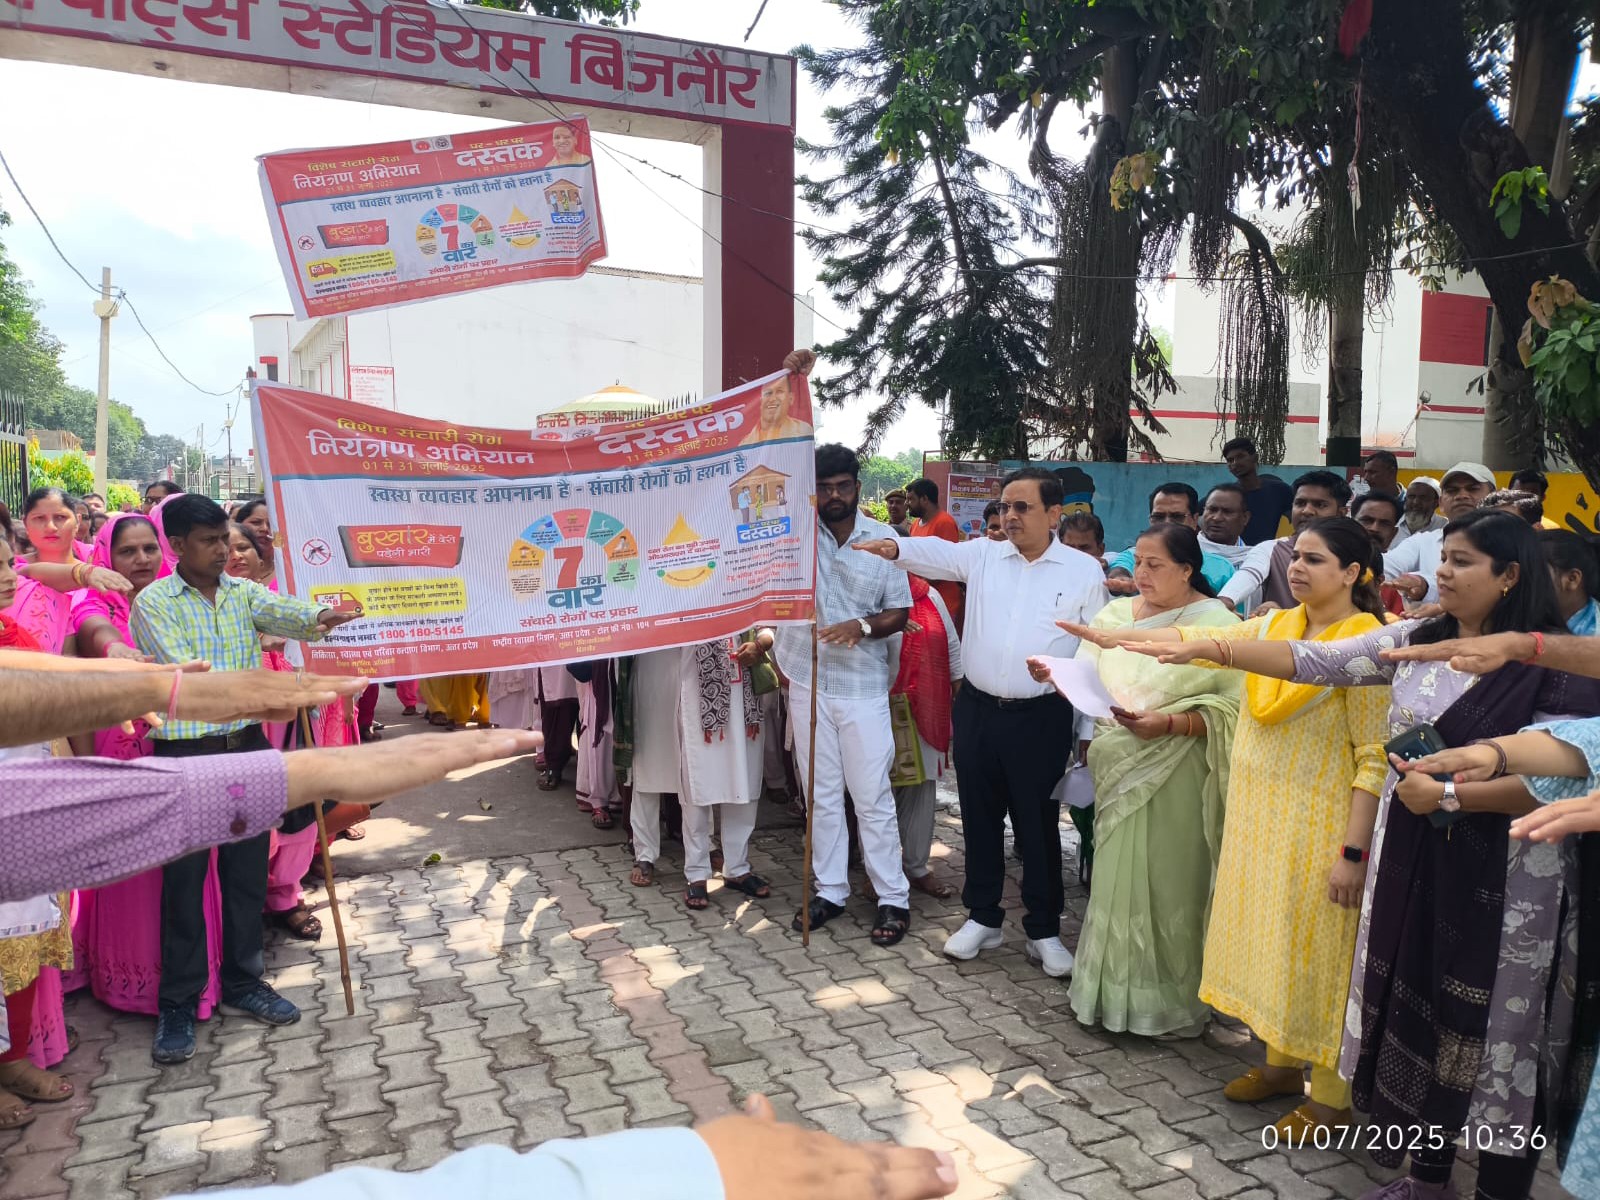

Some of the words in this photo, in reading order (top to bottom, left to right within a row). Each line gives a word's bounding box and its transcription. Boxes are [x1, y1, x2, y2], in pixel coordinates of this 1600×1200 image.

[279, 0, 547, 79] स्टेडियम
[564, 33, 761, 109] बिजनौर
[307, 162, 337, 172] विशेष
[378, 154, 401, 164] रोग
[453, 142, 544, 167] दस्तक
[293, 171, 354, 190] नियंत्रण
[359, 163, 421, 181] अभियान
[394, 190, 434, 204] अपनाना
[454, 183, 480, 197] संचारी
[482, 179, 501, 192] रोगों
[504, 178, 517, 189] को
[519, 175, 543, 188] हराना
[546, 172, 553, 183] है
[440, 224, 459, 250] 7
[441, 246, 478, 262] वार
[691, 402, 715, 416] पर
[336, 417, 388, 435] विशेष
[396, 427, 459, 443] संचारी
[464, 430, 503, 446] रोग
[594, 403, 746, 455] दस्तक
[704, 435, 729, 448] 2025
[305, 428, 415, 459] नियंत्रण
[425, 442, 535, 465] अभियान
[362, 460, 377, 471] 01
[382, 459, 393, 471] से
[399, 461, 413, 472] 31
[419, 460, 449, 475] जुलाई
[454, 462, 485, 473] 2025
[416, 487, 478, 504] व्यवहार
[484, 484, 552, 503] अपनाना
[557, 478, 571, 498] है
[588, 474, 635, 497] संचारी
[638, 466, 670, 491] रोगों
[673, 465, 693, 485] को
[696, 459, 731, 480] हराना
[734, 451, 748, 473] है
[356, 525, 428, 553] बुखार
[738, 521, 789, 540] दस्तक
[553, 546, 584, 589] 7
[580, 572, 603, 586] का
[546, 584, 607, 609] वार
[519, 613, 557, 628] संचारी
[559, 609, 588, 624] रोगों
[590, 609, 607, 619] पर
[608, 605, 639, 619] प्रहार
[378, 625, 465, 641] 1800-180-5145
